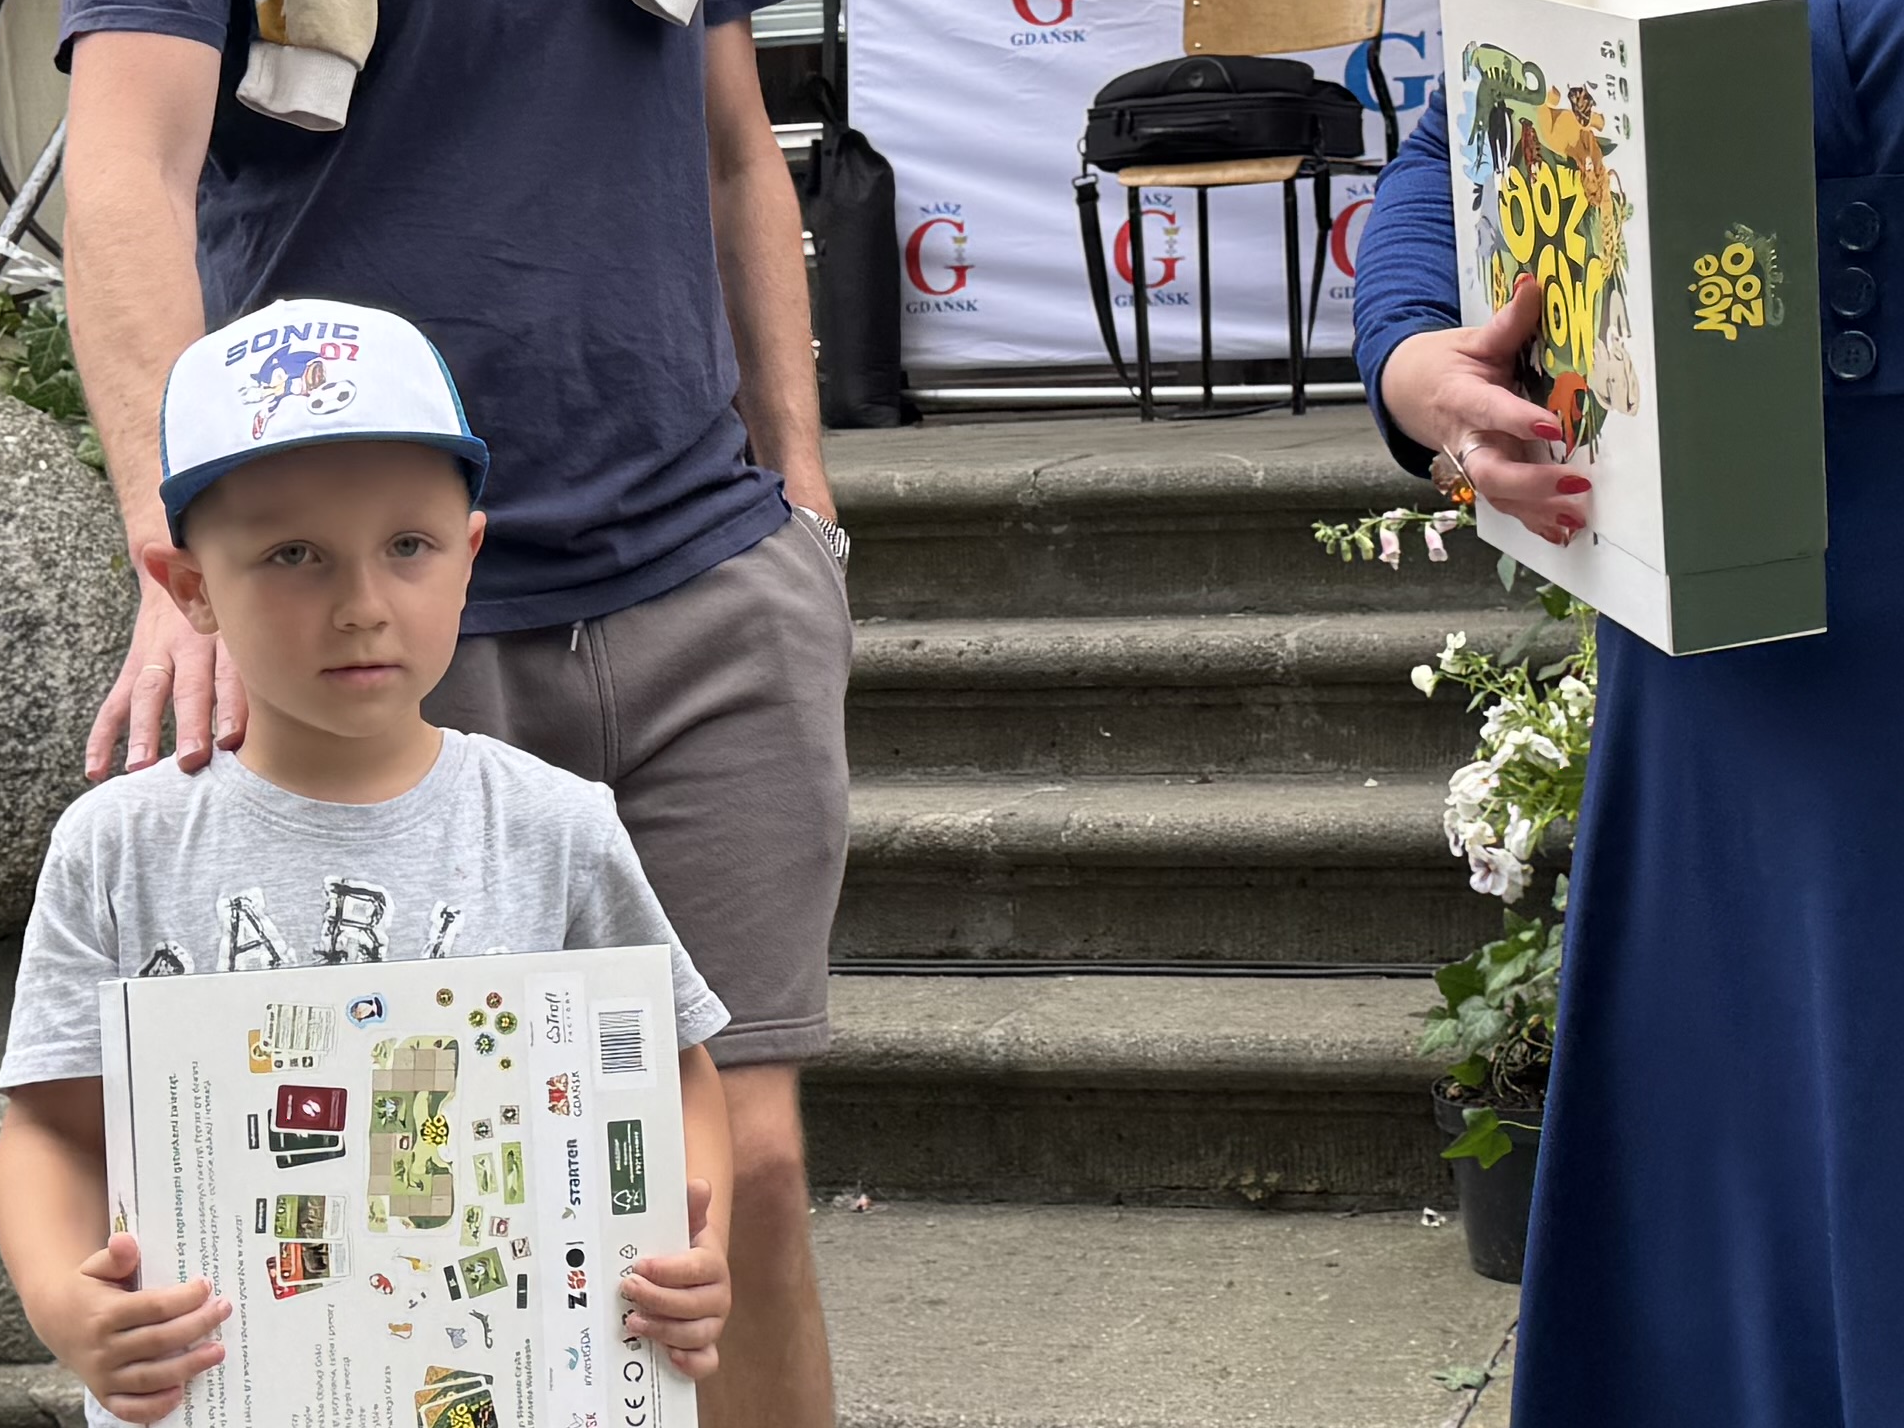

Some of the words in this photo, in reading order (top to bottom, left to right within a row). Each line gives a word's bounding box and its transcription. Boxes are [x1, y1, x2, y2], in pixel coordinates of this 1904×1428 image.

[1010, 27, 1087, 47] GDAŃSK
[918, 201, 963, 218] NASZ
[1141, 192, 1173, 208] ASZ
[904, 217, 976, 296] G
[906, 294, 979, 314] GDAŃSK
[1687, 254, 1738, 341] Moje
[1536, 244, 1606, 372] Moj
[224, 322, 360, 367] SONIC
[320, 342, 360, 361] 07
